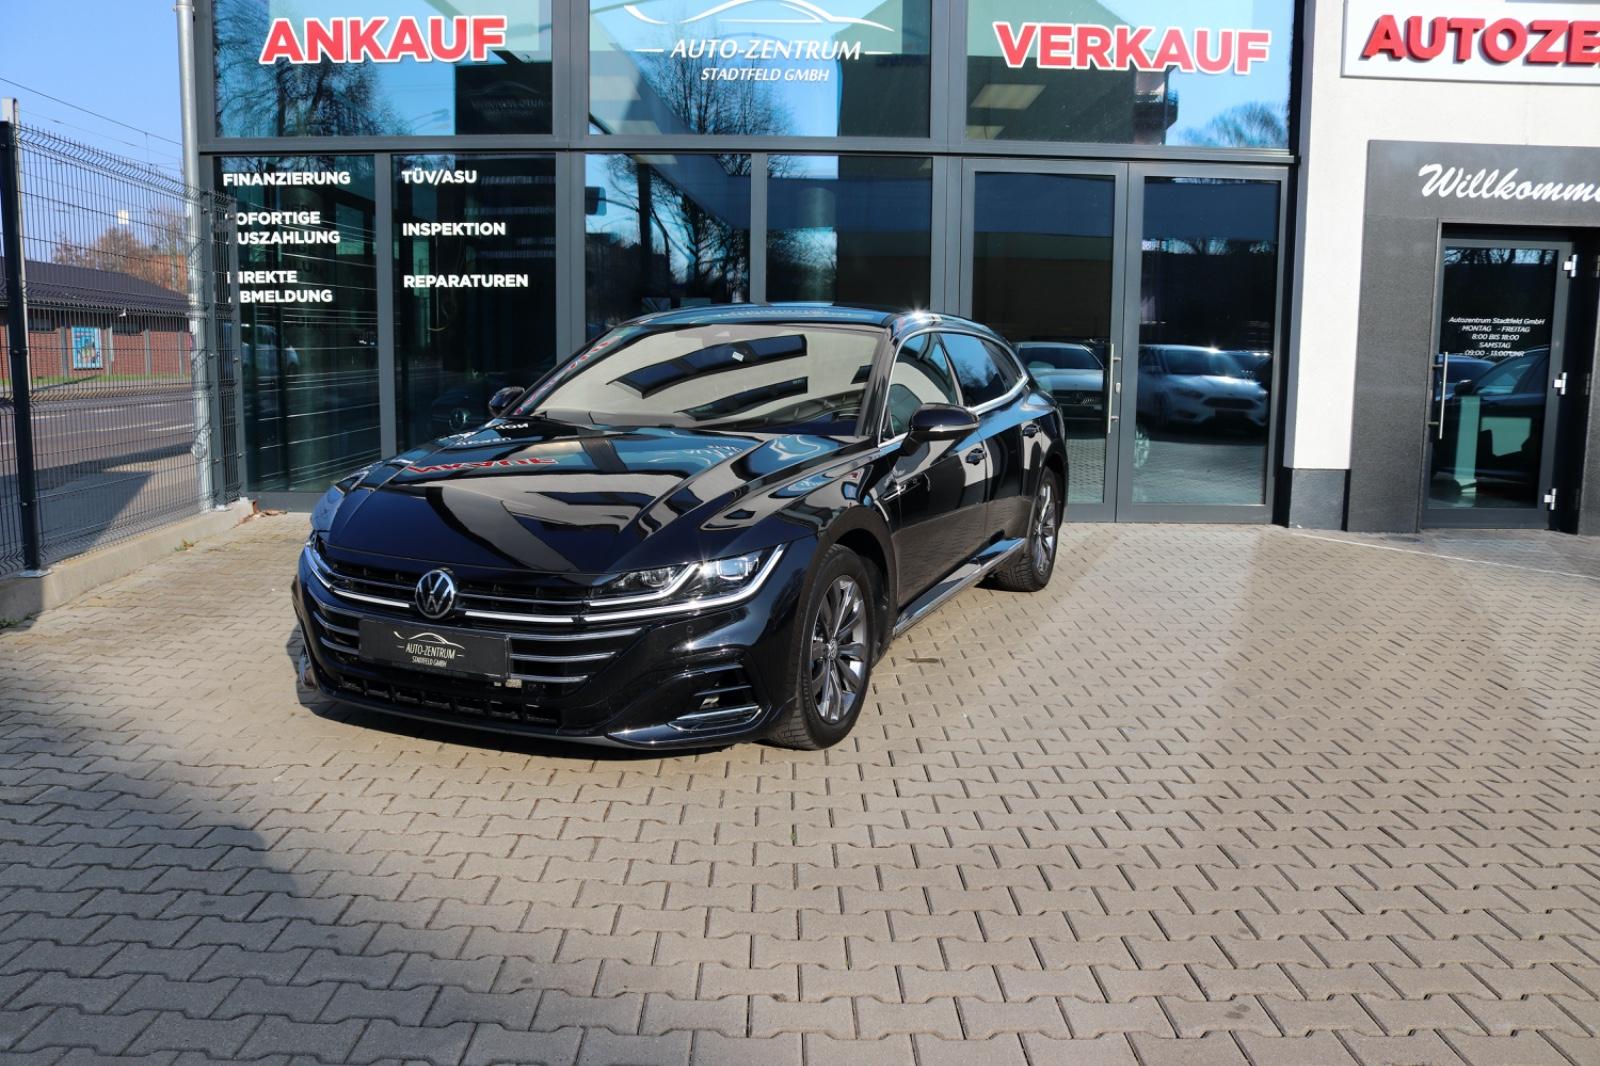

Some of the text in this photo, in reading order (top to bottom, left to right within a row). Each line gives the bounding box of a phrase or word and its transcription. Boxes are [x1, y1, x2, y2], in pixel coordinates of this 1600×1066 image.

[258, 15, 507, 64] ANKAUF
[1359, 14, 1600, 67] AUTOZE
[670, 38, 862, 61] AUTO-ZENTRUM
[992, 21, 1272, 75] VERKAUF
[700, 67, 830, 82] STADTFELD GMBH
[222, 171, 351, 187] FINANZIERUNG
[401, 169, 478, 185] TÜV/ASU
[225, 211, 321, 226] OFORTIGE
[402, 221, 506, 237] INSPEKTION
[226, 230, 341, 245] USZAHLUNG
[403, 273, 529, 289] REPARATUREN
[228, 289, 334, 304] BMELDUNG
[1448, 316, 1492, 324] Autozentrum
[1501, 325, 1531, 333] FREITAG
[1479, 341, 1512, 349] SAMSTAG
[405, 642, 456, 660] AUTO-ZENTRUM
